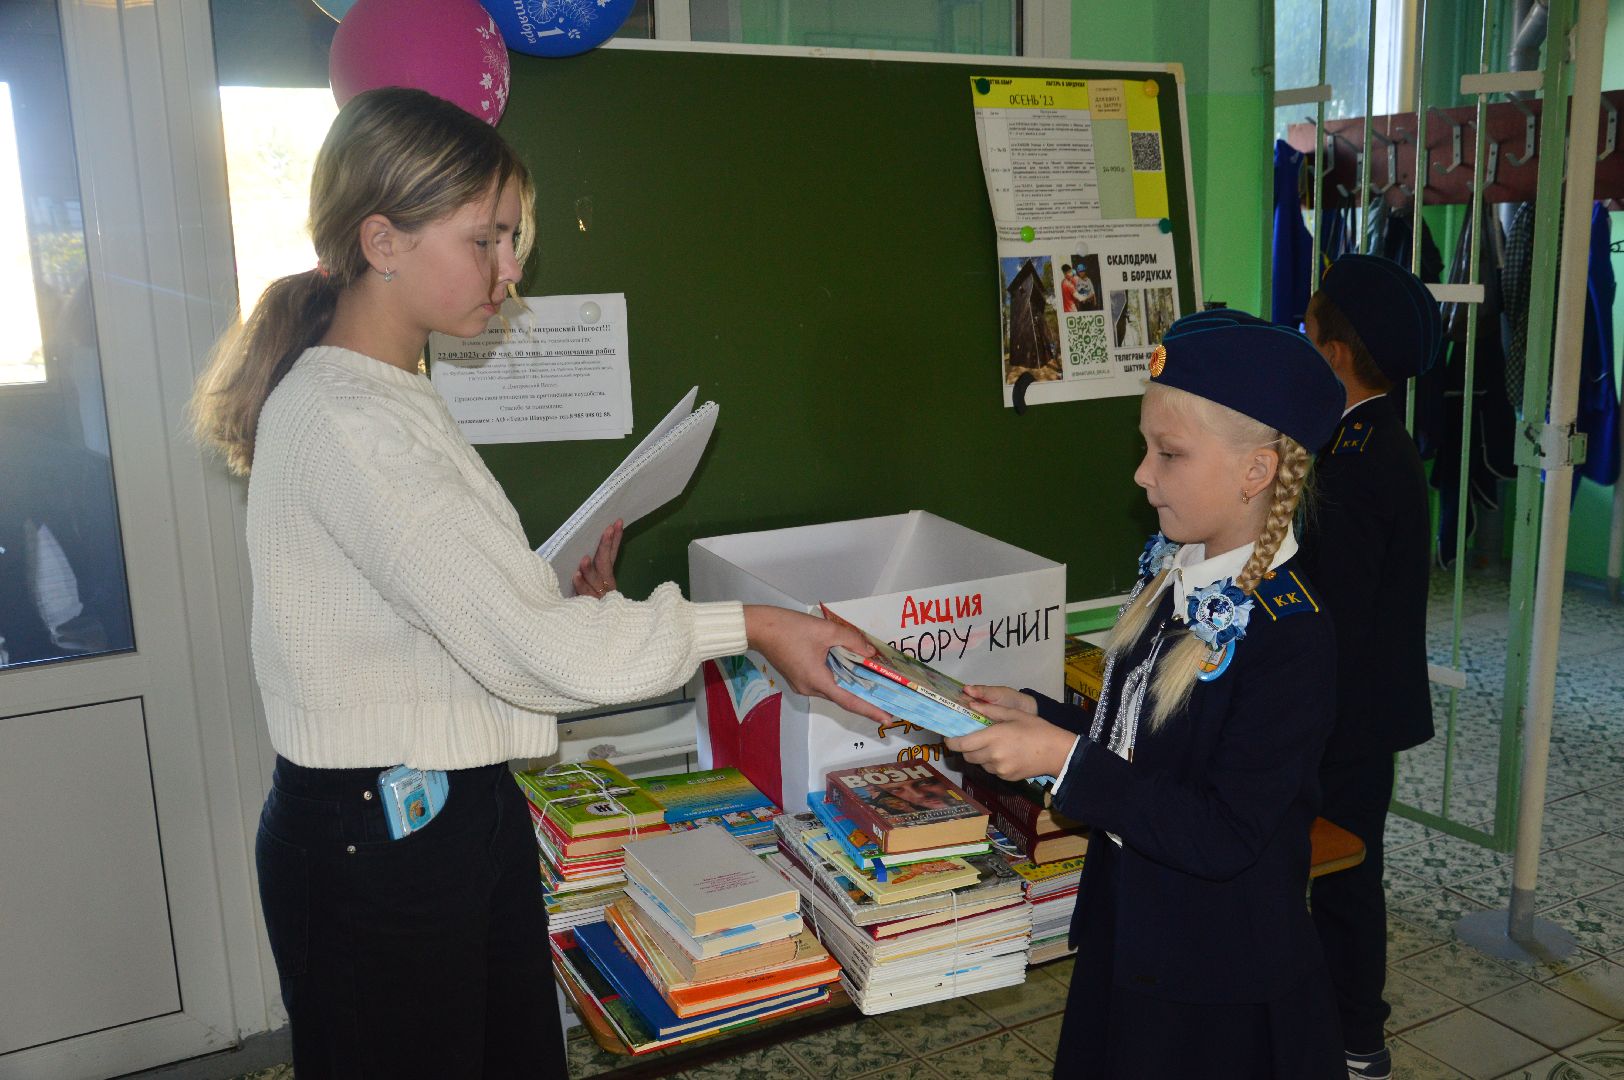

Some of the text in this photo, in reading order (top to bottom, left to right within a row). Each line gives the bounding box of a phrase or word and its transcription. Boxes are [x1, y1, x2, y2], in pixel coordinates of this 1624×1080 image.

[1106, 253, 1157, 266] СКАЛОДРОМ
[1122, 269, 1172, 282] В БОРДУКАХ
[554, 348, 594, 356] окончания
[595, 346, 616, 356] работ
[1342, 439, 1360, 447] КК
[1273, 591, 1302, 608] КК
[901, 593, 983, 628] Акция
[989, 604, 1060, 652] КНИГ
